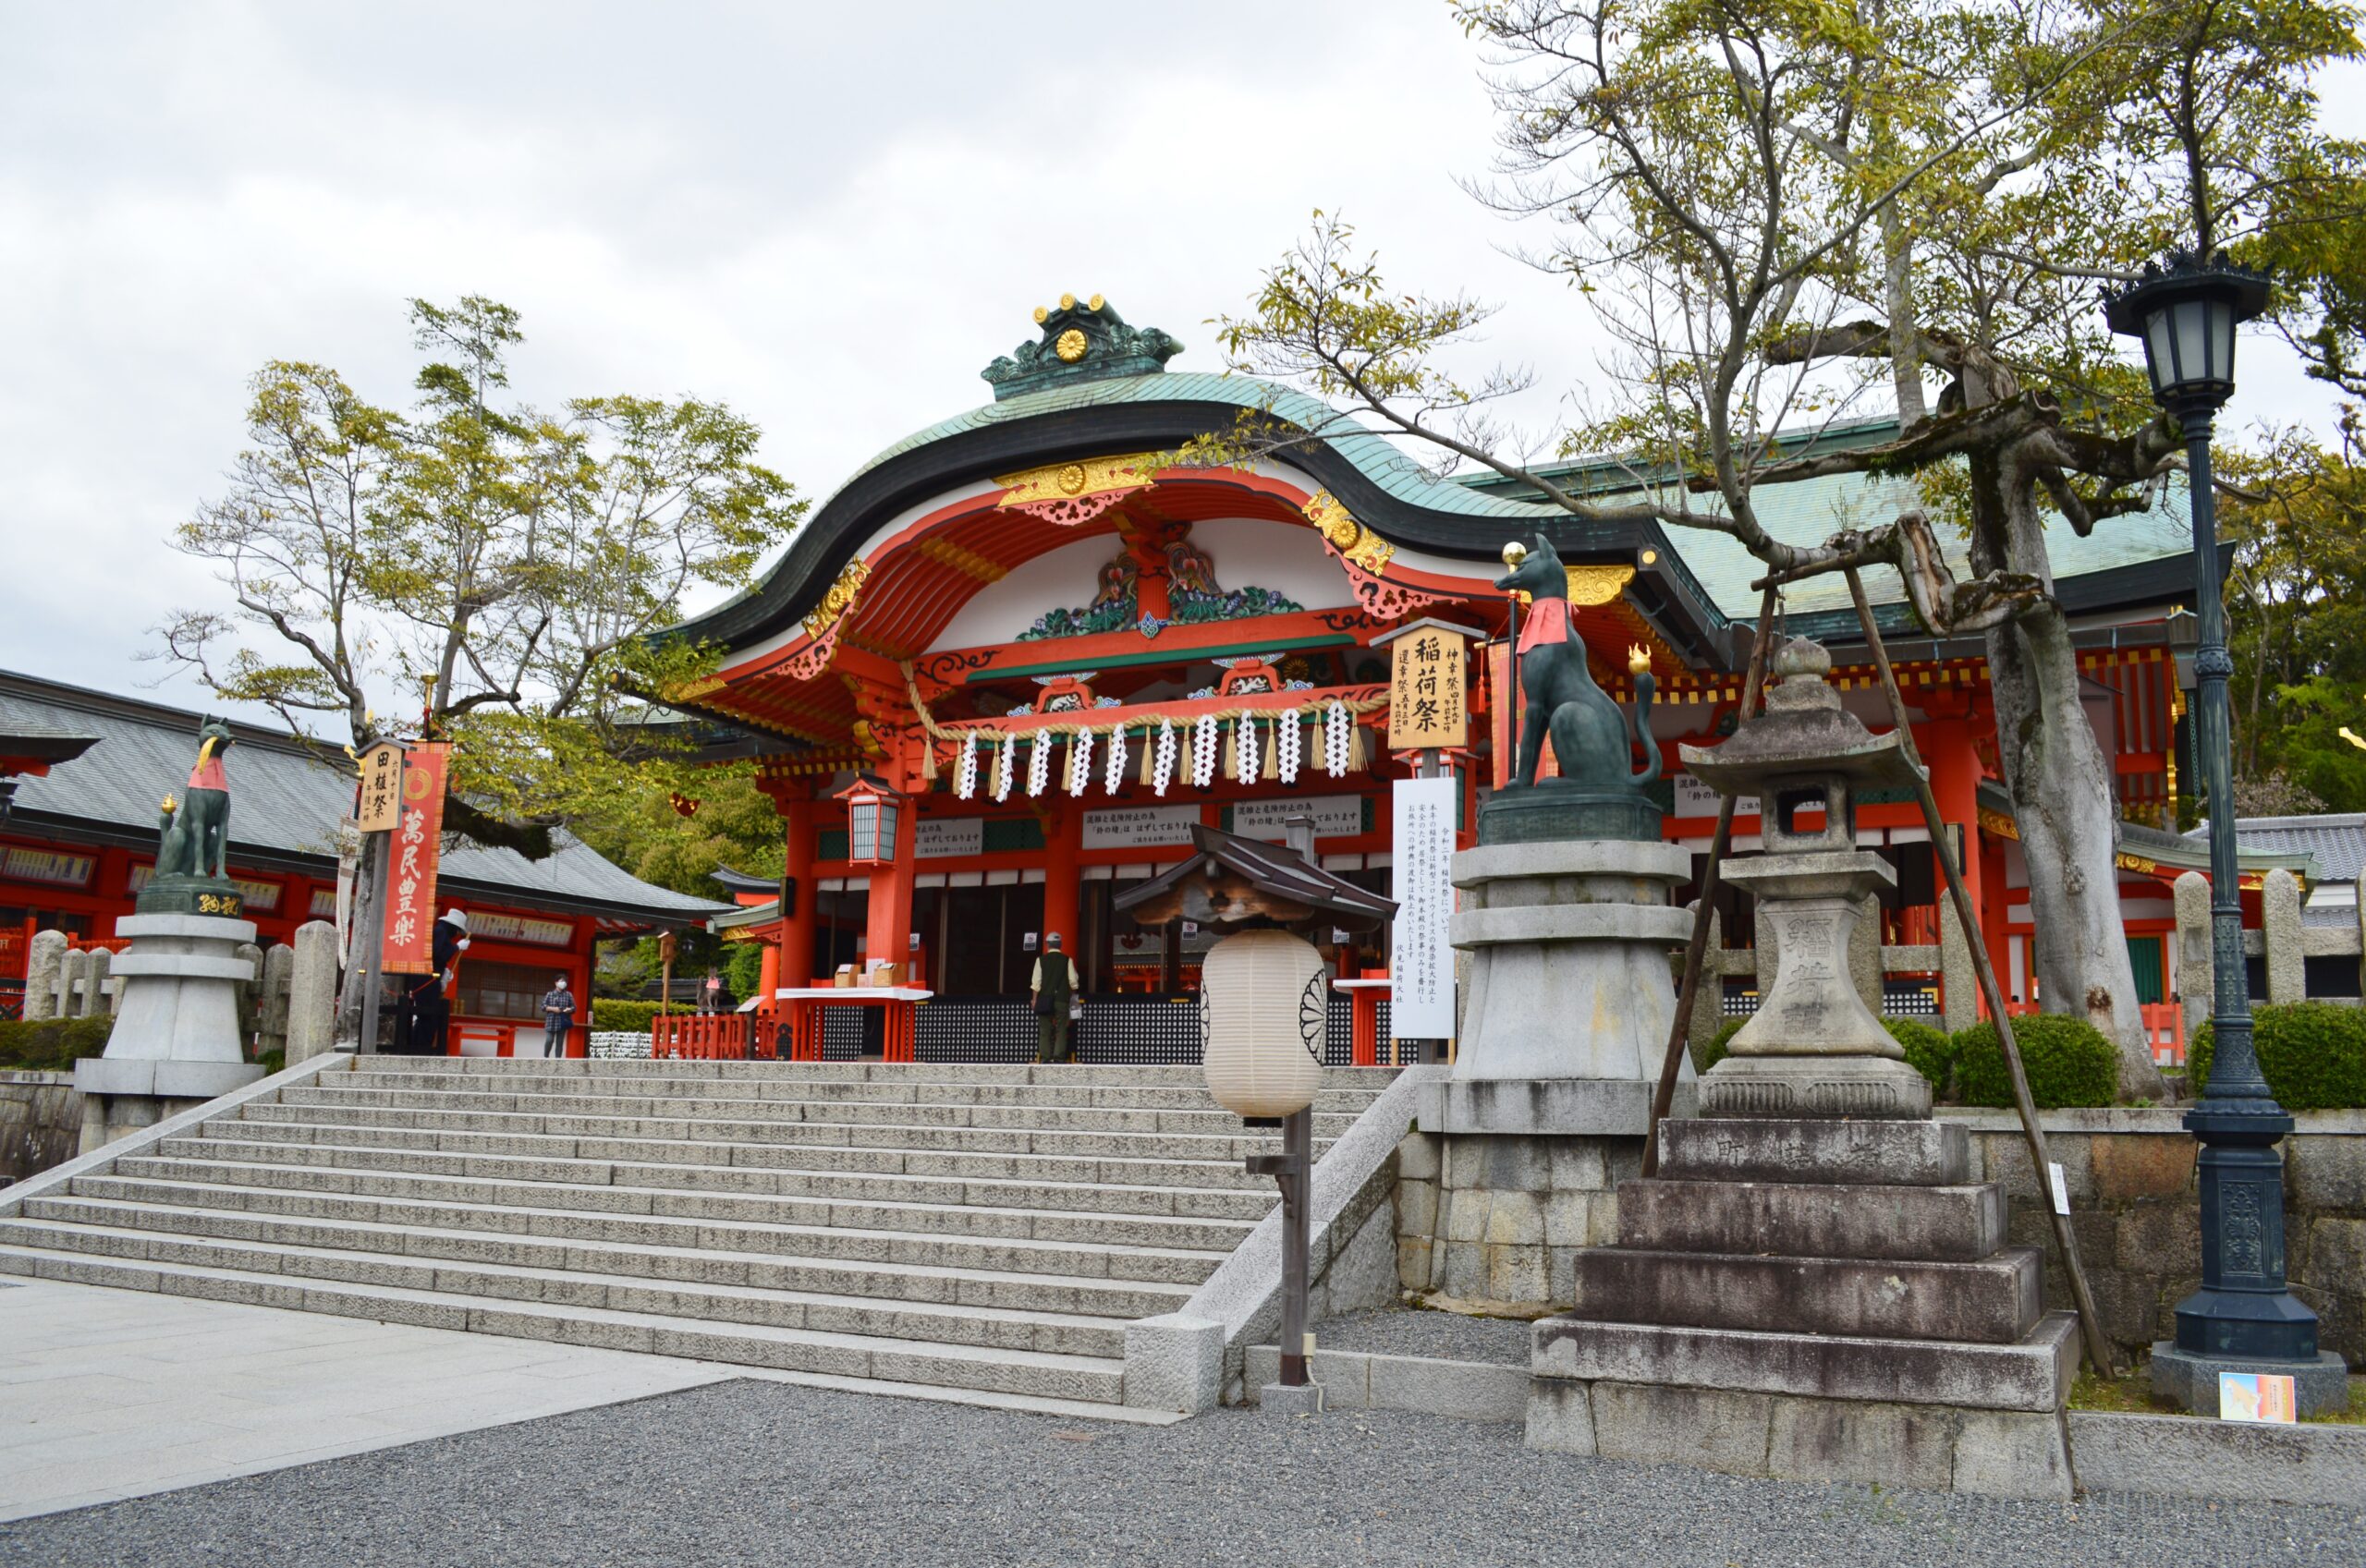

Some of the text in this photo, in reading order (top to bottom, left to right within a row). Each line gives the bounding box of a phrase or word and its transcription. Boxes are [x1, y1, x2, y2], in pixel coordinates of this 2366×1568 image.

[1411, 636, 1440, 733] 稲荷祭
[373, 751, 389, 820] 田植祭
